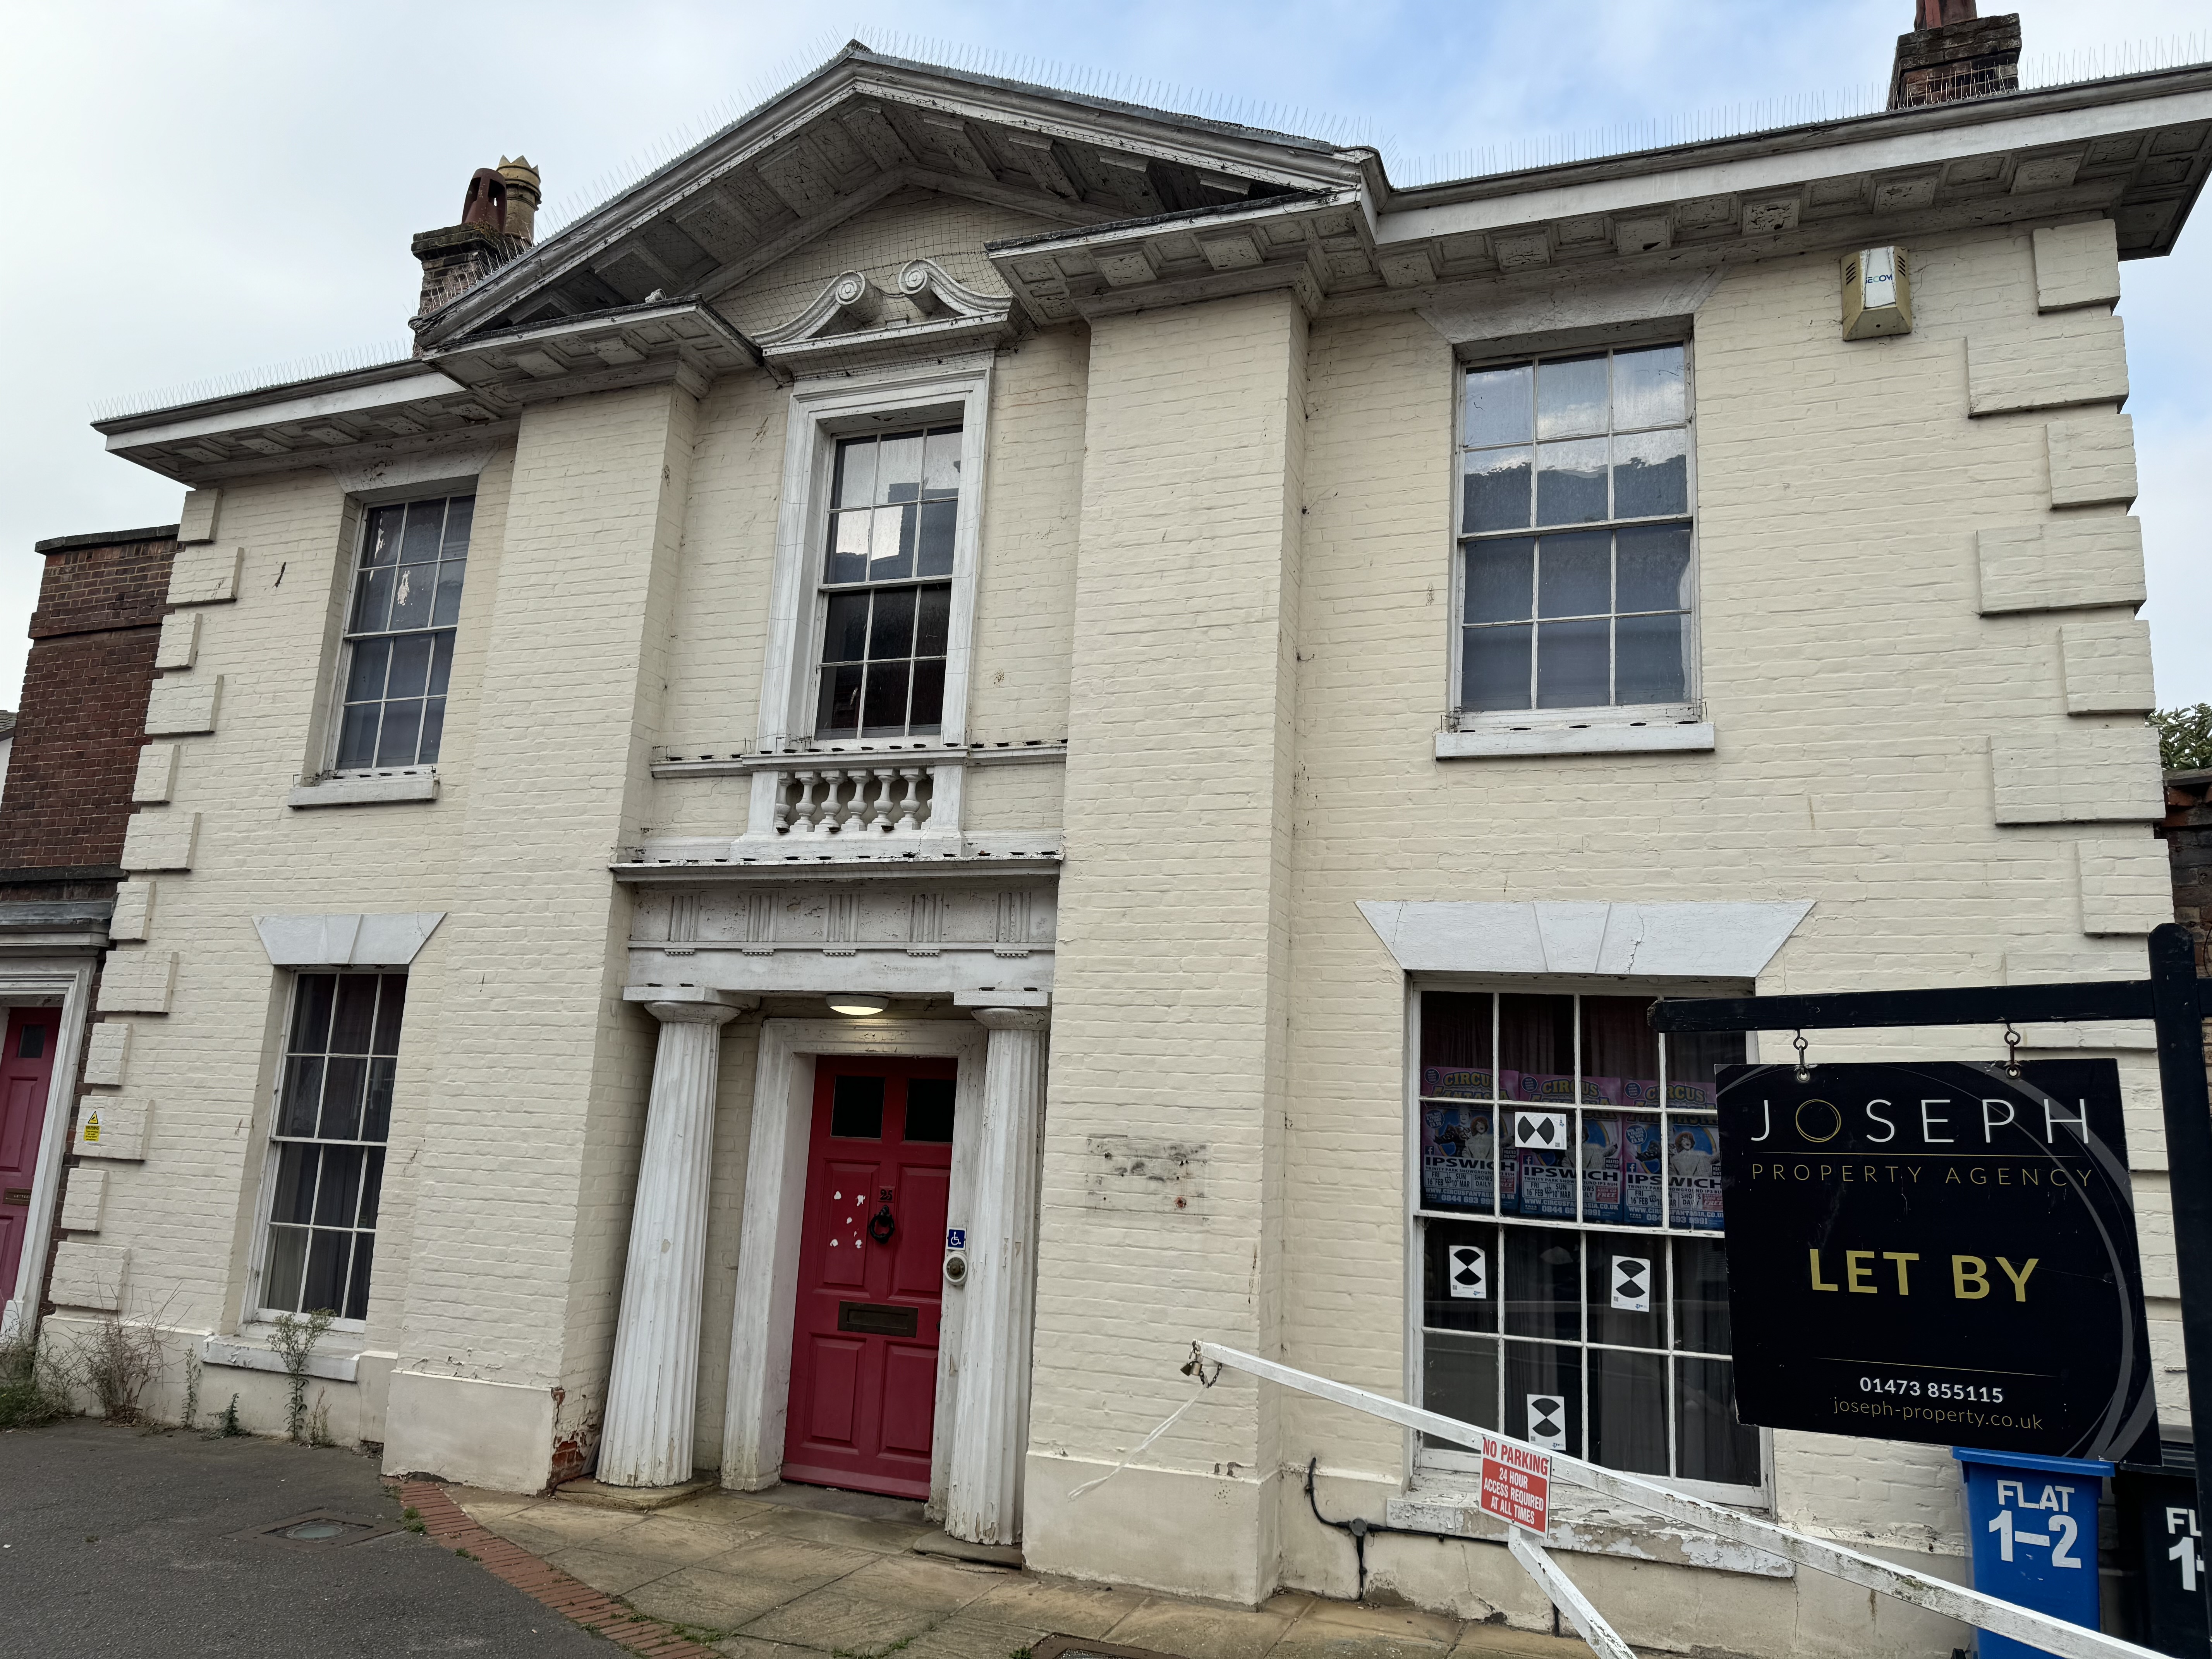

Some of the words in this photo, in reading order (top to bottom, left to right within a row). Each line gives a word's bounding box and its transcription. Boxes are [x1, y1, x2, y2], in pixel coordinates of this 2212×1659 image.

[1444, 1072, 1494, 1087] CIRCU
[1751, 1099, 2088, 1144] JOSEPH
[1525, 1167, 1618, 1181] IPSWICH
[1628, 1175, 1722, 1188] IPSWICH
[1752, 1164, 1922, 1183] PROPERTY
[1946, 1167, 2092, 1187] AGENCY
[879, 1189, 893, 1200] 25
[1524, 1198, 1618, 1210] WWW.CIRCUSFAASIA.CO.UK
[1542, 1205, 1563, 1213] 0844
[1810, 1249, 1919, 1295] LET
[1952, 1255, 2039, 1302] BY
[1860, 1377, 1920, 1396] 01473
[1928, 1383, 2003, 1403] 855115
[1833, 1397, 2043, 1430] joseph-property.co.uk
[1483, 1438, 1497, 1458] NO
[1501, 1444, 1548, 1476] PARKING
[1499, 1467, 1507, 1482] 24
[1510, 1470, 1528, 1489] HOUR
[1484, 1477, 1508, 1498] ACCESS
[1510, 1487, 1544, 1511] REQUIRED
[1997, 1479, 2075, 1512] FLAT
[1491, 1496, 1499, 1510] AT
[1500, 1499, 1512, 1516] ALL
[1514, 1504, 1535, 1525] TIMES
[2166, 1507, 2202, 1537] FL
[1989, 1510, 2081, 1568] 1-2
